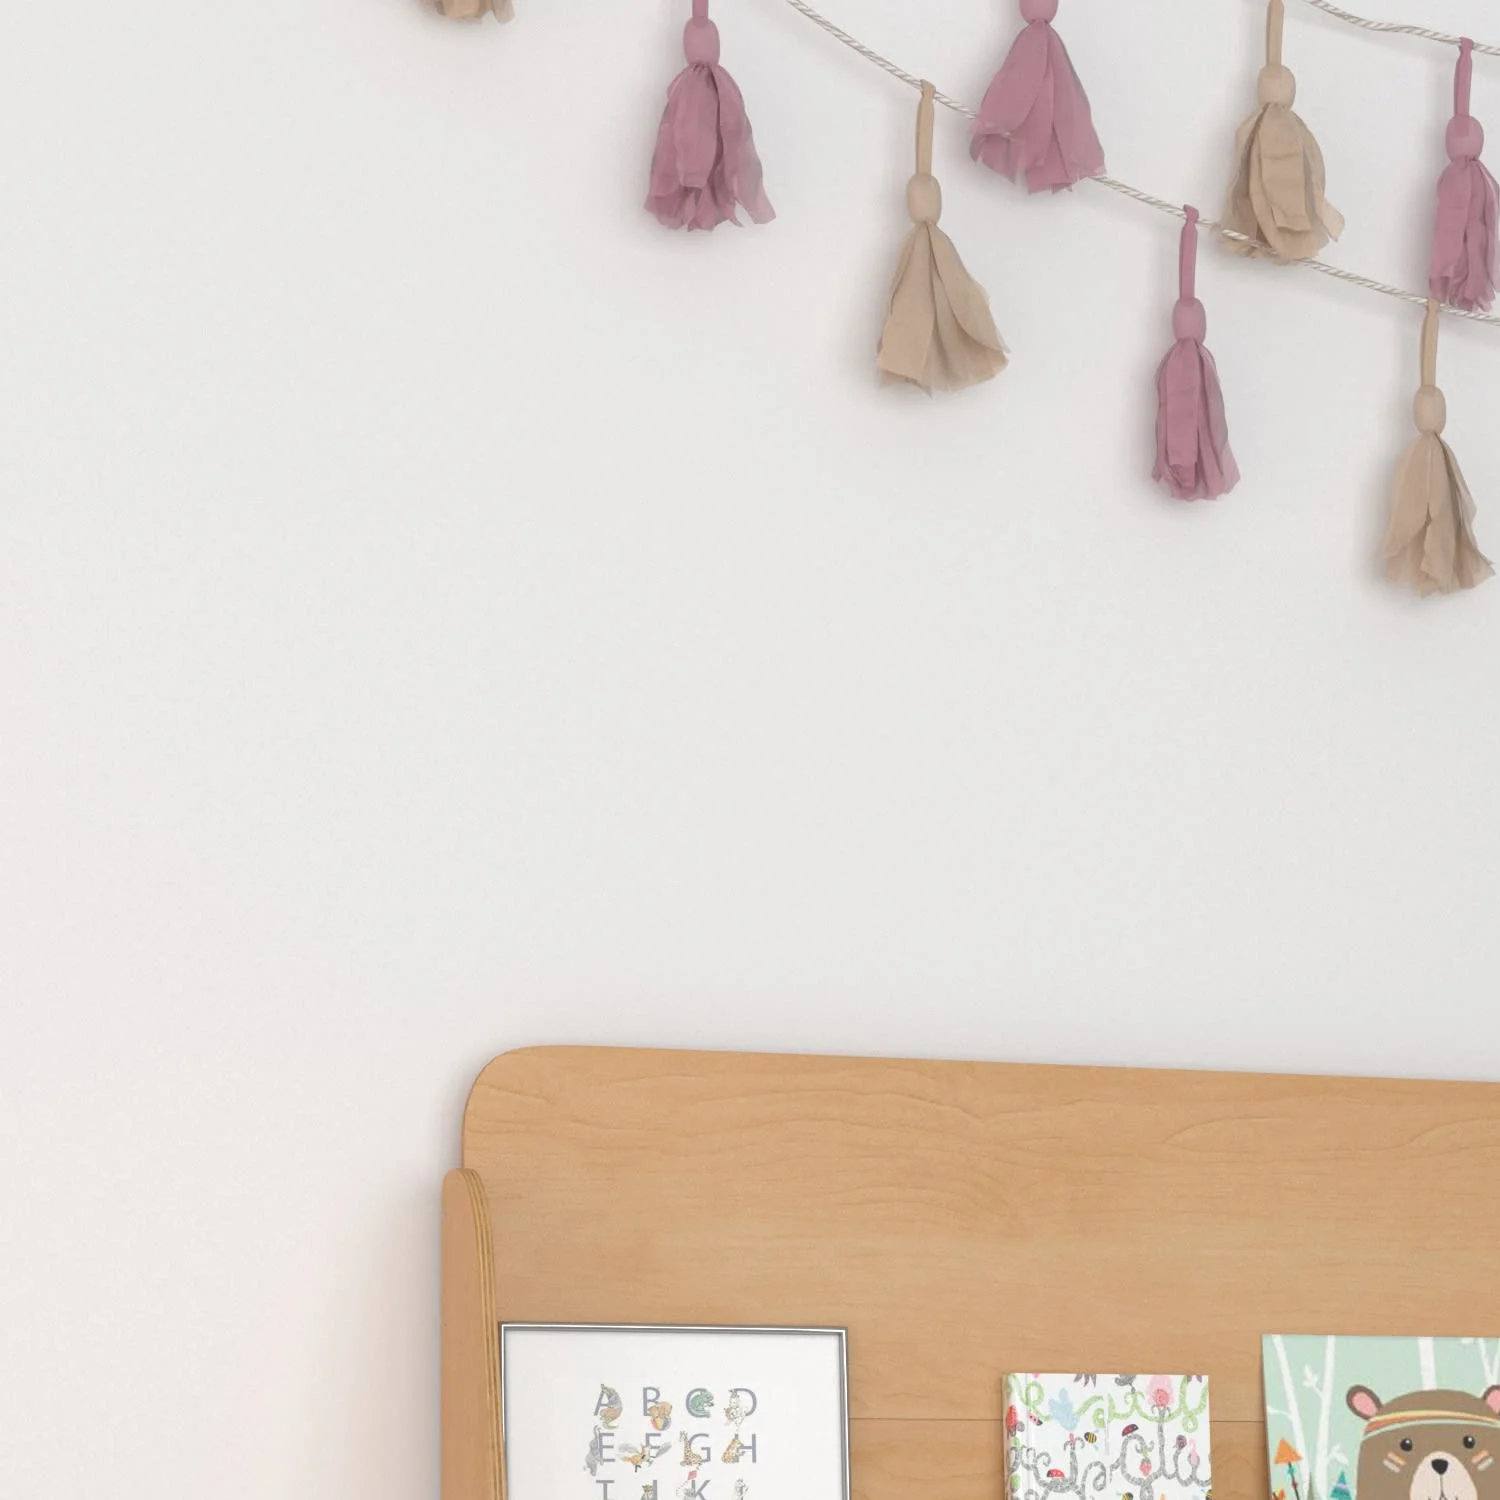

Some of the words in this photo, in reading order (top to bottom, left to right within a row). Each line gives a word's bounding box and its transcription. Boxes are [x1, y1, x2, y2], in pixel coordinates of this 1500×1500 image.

[643, 1387, 664, 1417] B
[600, 1433, 615, 1463] E
[689, 1433, 711, 1463] G
